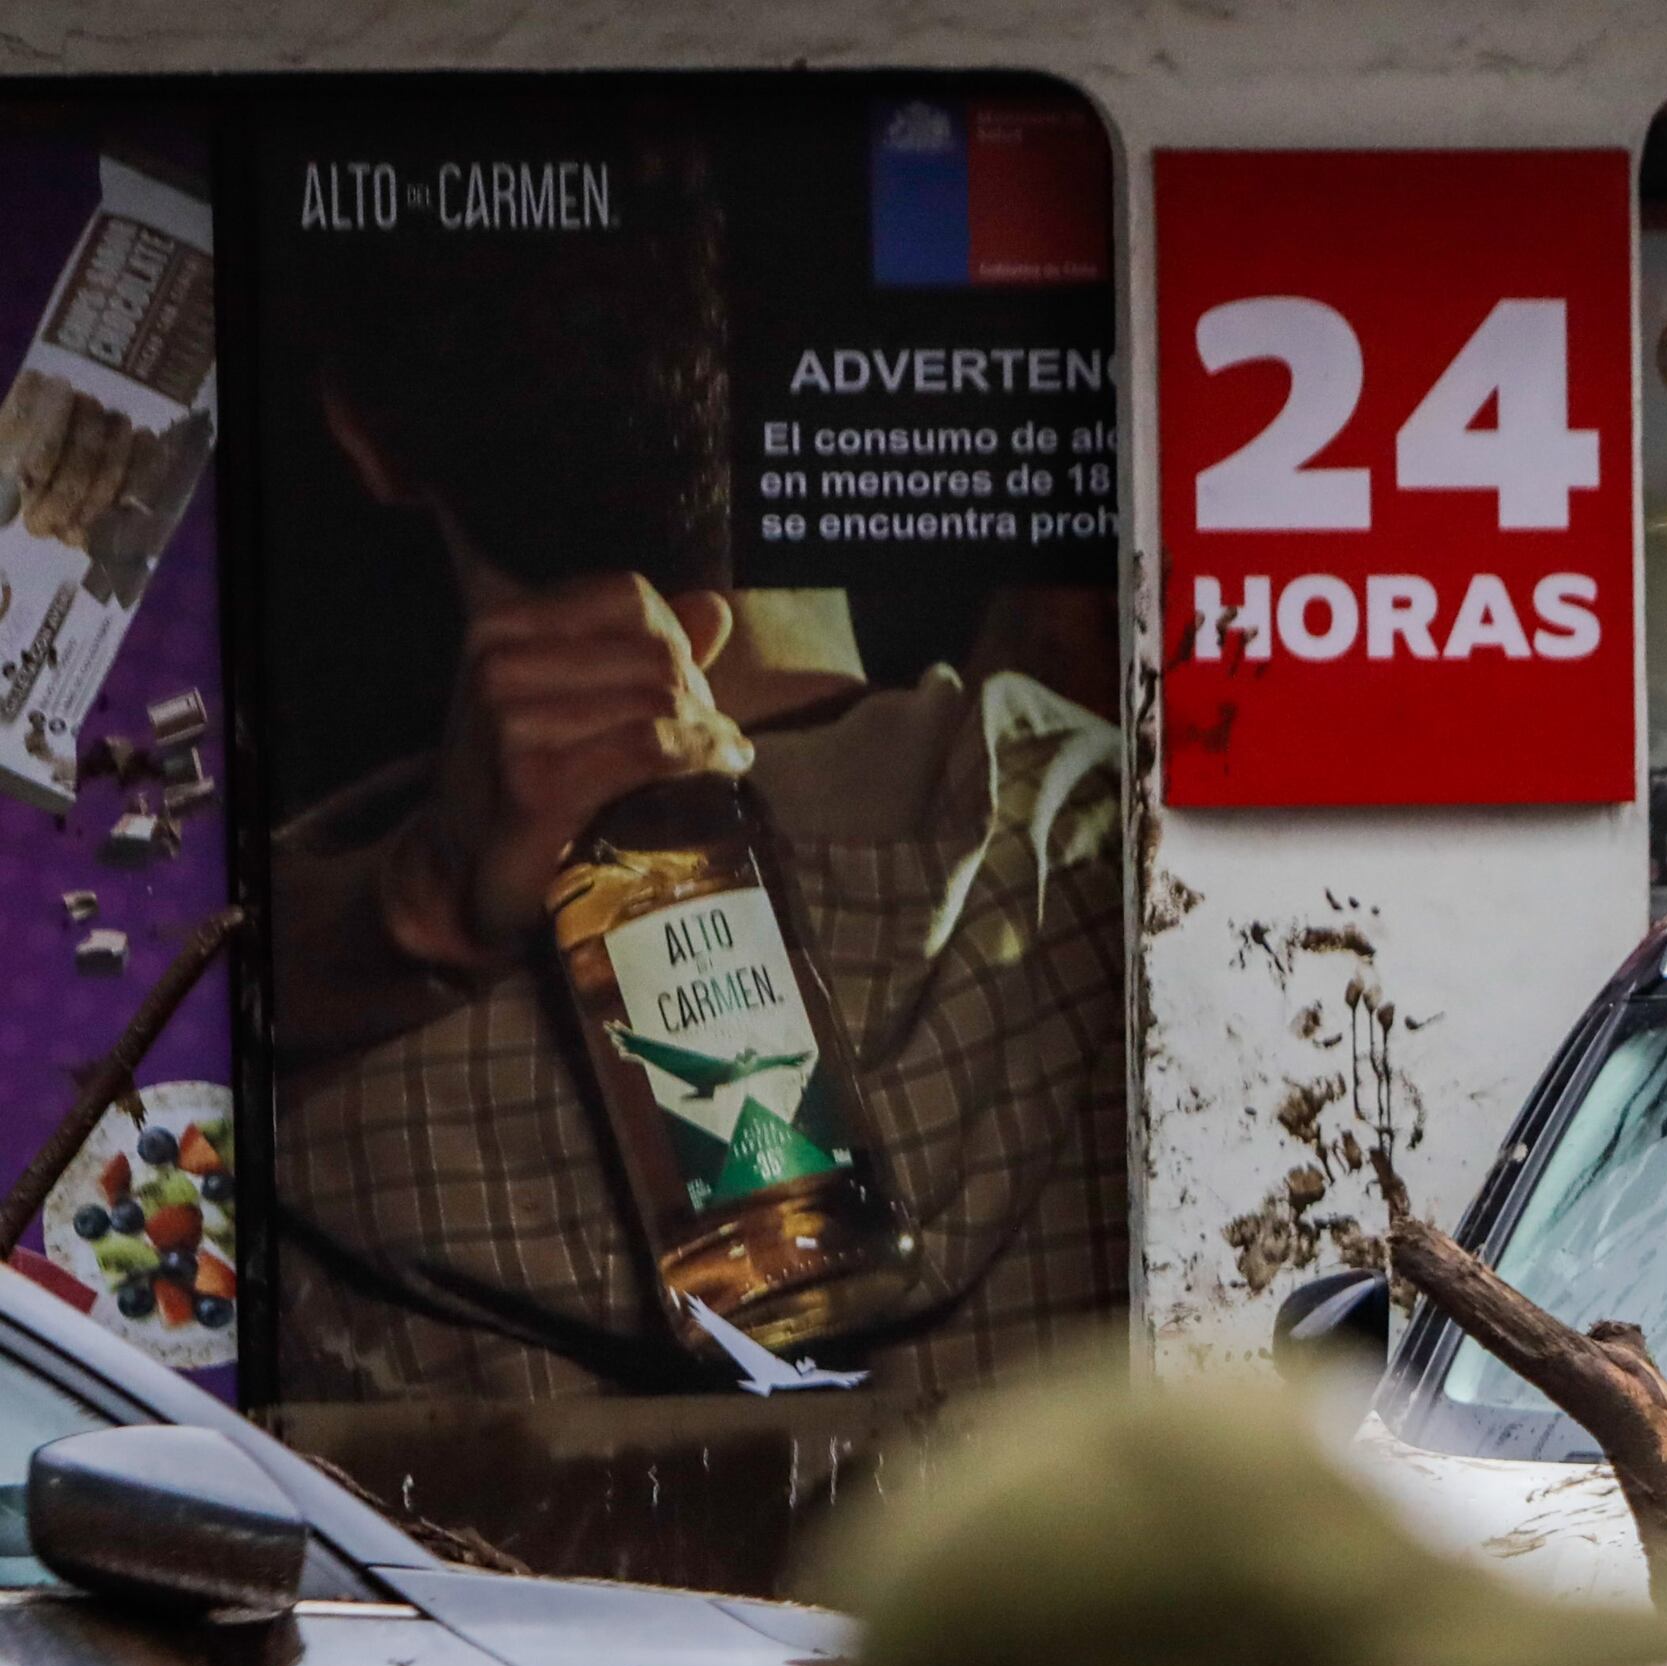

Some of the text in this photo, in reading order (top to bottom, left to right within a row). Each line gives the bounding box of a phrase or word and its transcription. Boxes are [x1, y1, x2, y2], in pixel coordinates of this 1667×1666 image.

[302, 161, 397, 231] ALTO
[439, 161, 609, 231] CARMEN
[790, 349, 1116, 392] ADVERTEN
[763, 421, 800, 454] El
[814, 427, 999, 452] consumo
[1011, 420, 1058, 452] de
[1195, 295, 1601, 532] 24
[760, 462, 1111, 498] en menores de 18
[761, 513, 807, 541] se
[819, 506, 1017, 540] encuentra
[1194, 572, 1602, 662] HORAS
[664, 908, 734, 966] ALTO
[657, 963, 777, 1034] CARMEN
